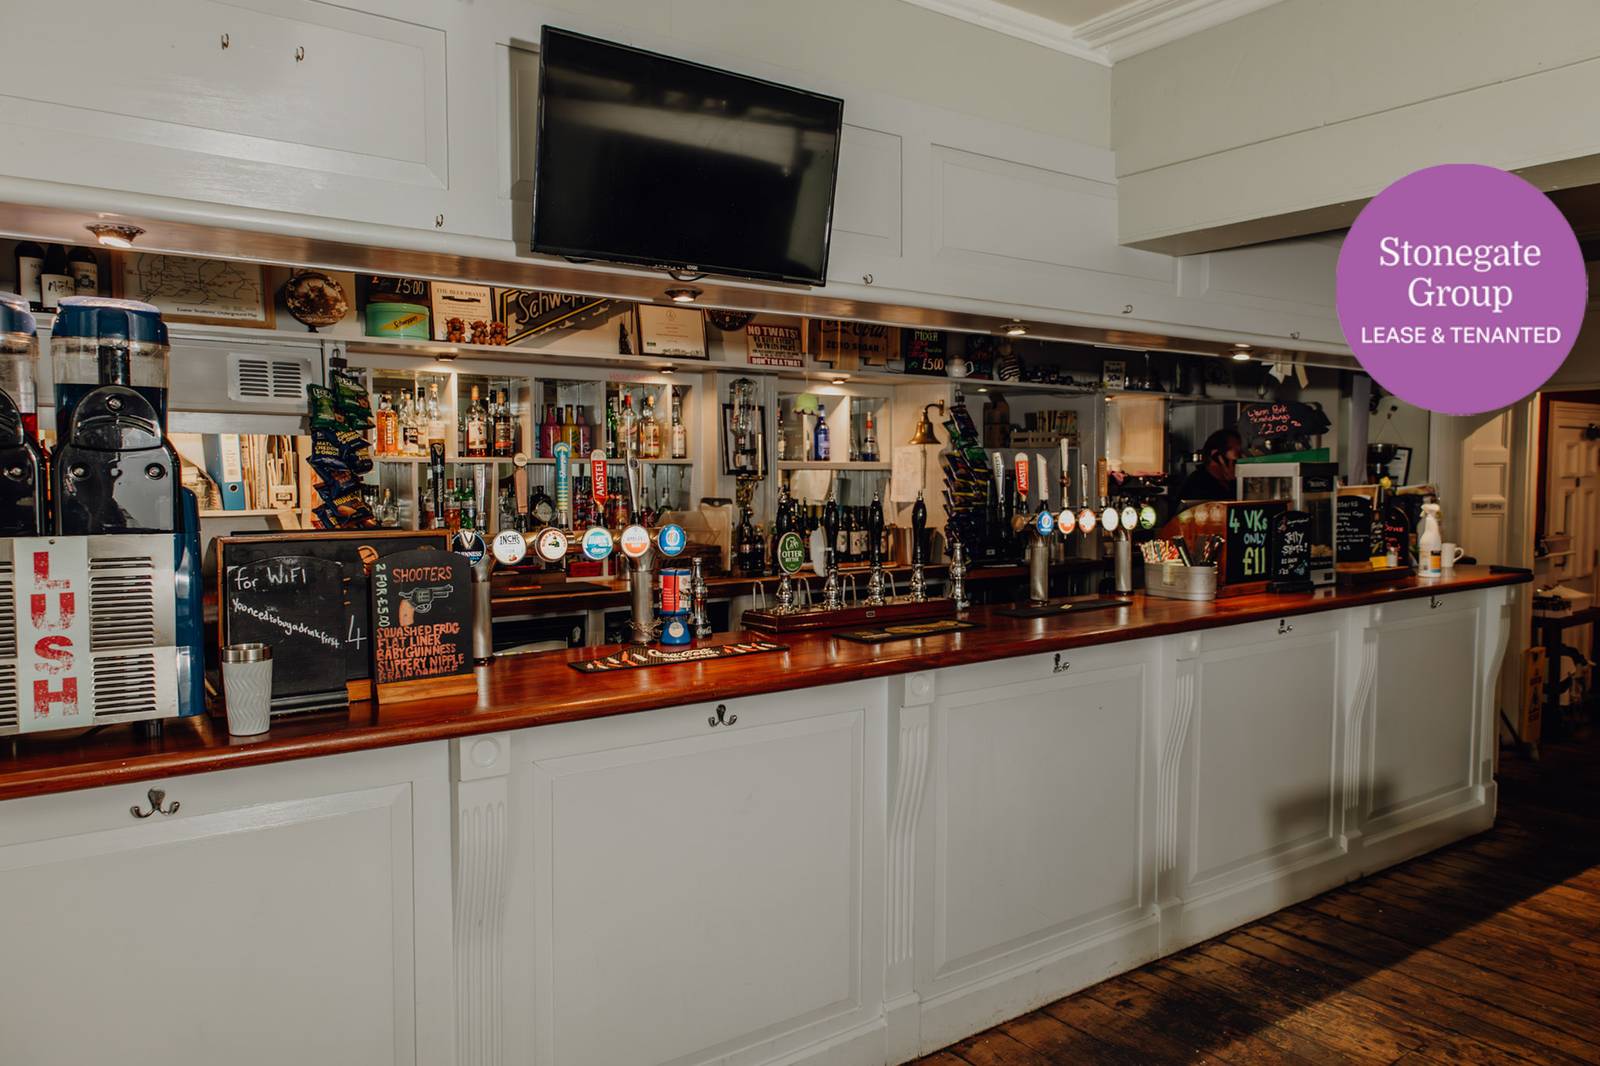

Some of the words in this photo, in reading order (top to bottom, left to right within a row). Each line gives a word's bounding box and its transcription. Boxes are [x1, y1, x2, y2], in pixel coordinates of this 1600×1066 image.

[747, 325, 761, 335] NO
[595, 461, 605, 497] AMSTEL
[1016, 462, 1027, 489] AMSTEL
[1229, 508, 1241, 534] 4
[1243, 509, 1268, 532] VKs
[1243, 533, 1266, 545] ONLY
[781, 550, 803, 558] OTTER
[1242, 546, 1266, 576] £11
[392, 566, 452, 582] SHOOTERS
[375, 575, 387, 596] FOR
[31, 552, 79, 719] LUSH
[377, 624, 432, 639] SQUASHED
[433, 622, 461, 637] FROG
[377, 636, 407, 650] FLAT
[410, 633, 442, 648] LINER
[377, 658, 427, 675] SLIPPERY
[429, 653, 465, 670] NIPPLE
